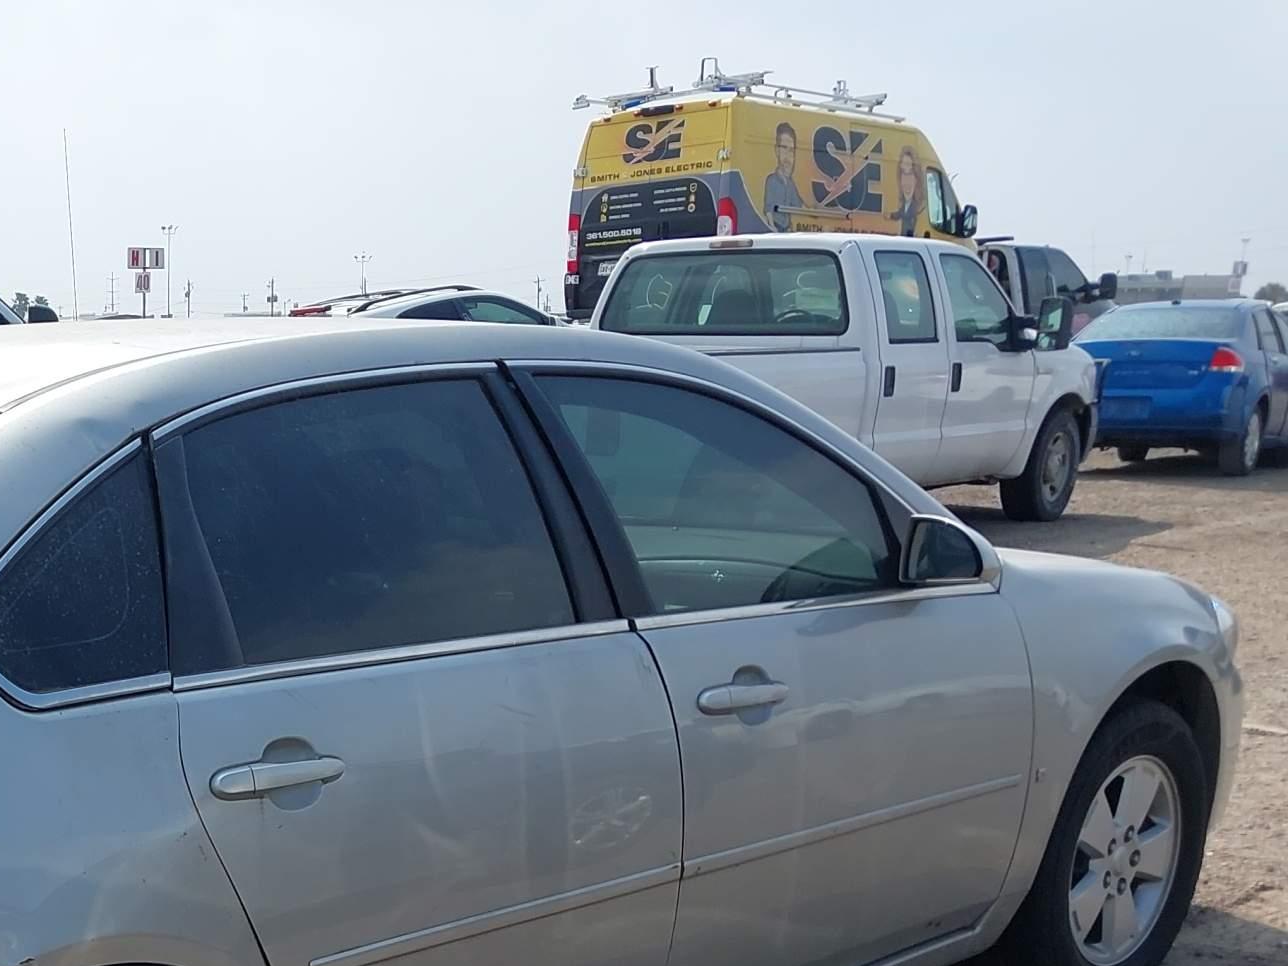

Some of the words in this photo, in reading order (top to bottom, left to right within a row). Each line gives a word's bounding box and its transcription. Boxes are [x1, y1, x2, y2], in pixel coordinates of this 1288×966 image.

[590, 172, 620, 183] SMITH
[630, 167, 663, 178] JONES
[664, 160, 713, 173] ELECTRIC
[796, 222, 823, 233] SMITH
[131, 250, 139, 267] H
[136, 274, 150, 290] 40
